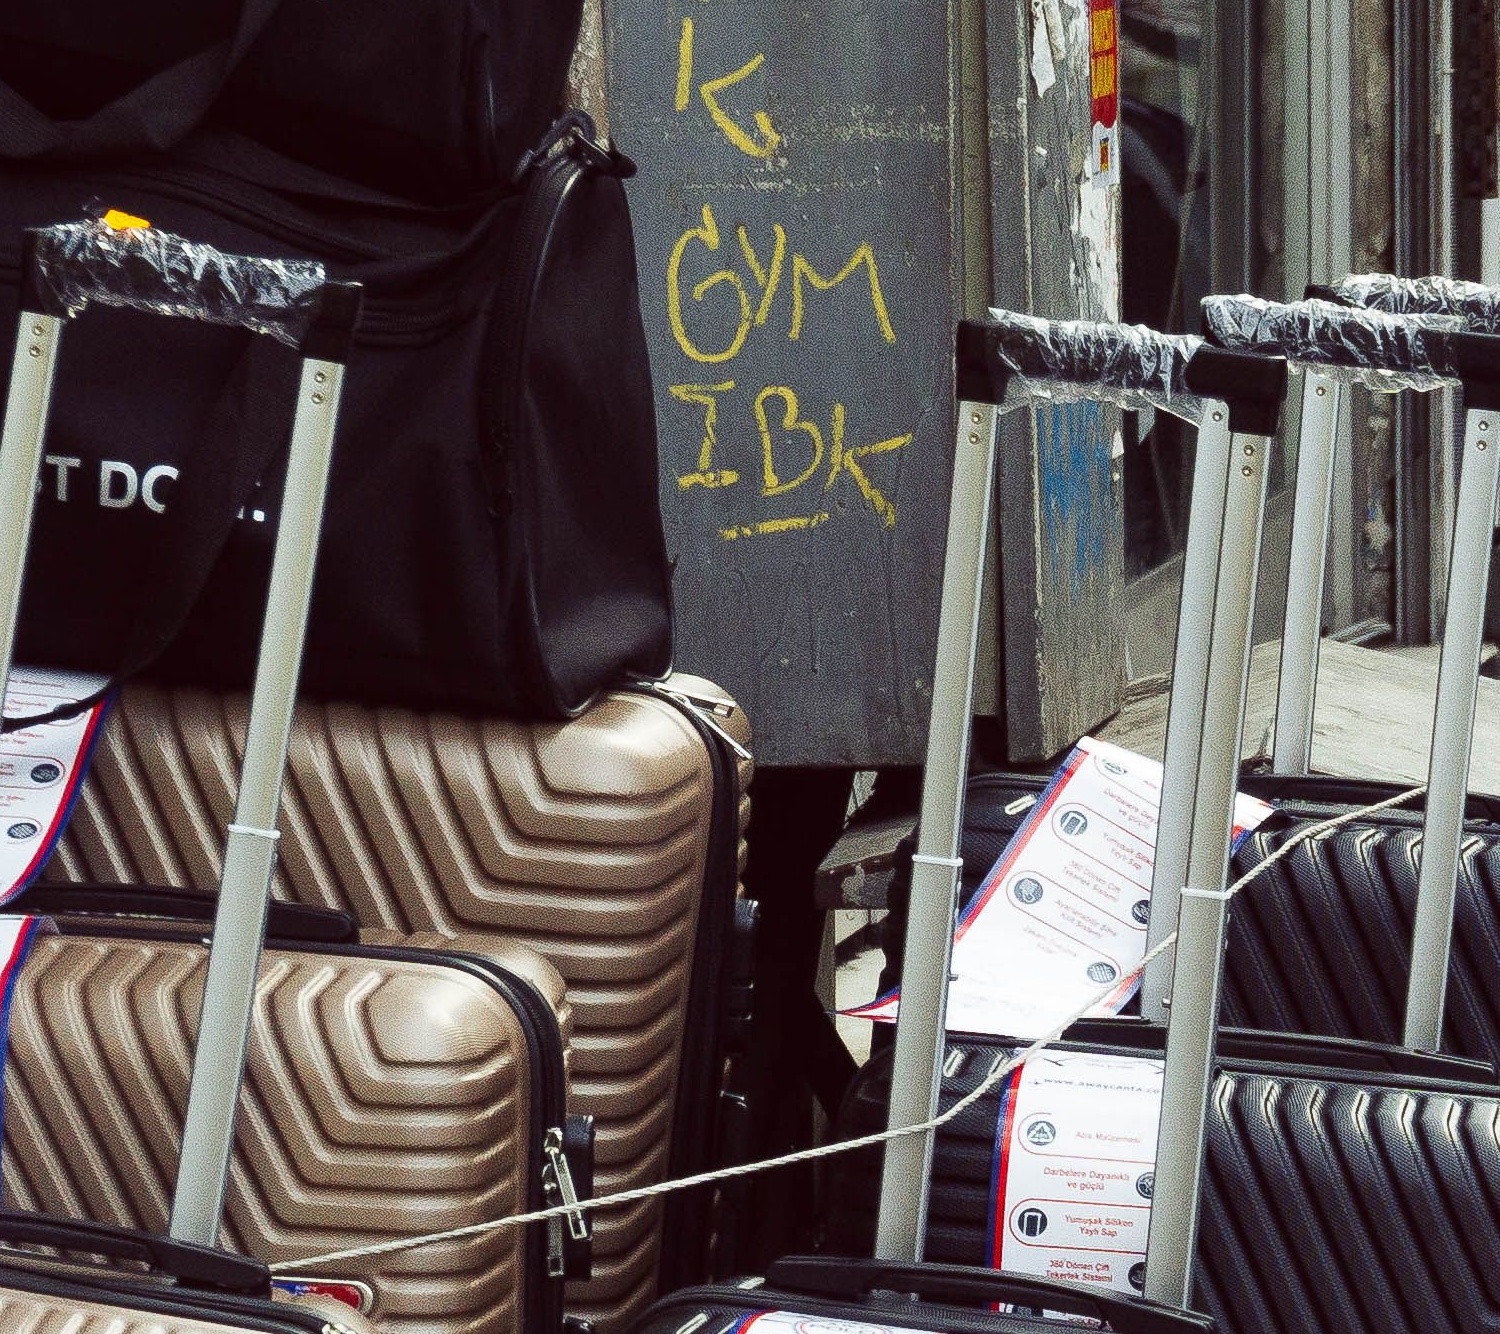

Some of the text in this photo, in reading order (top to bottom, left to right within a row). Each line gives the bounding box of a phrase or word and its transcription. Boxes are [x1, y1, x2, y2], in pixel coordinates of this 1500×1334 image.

[667, 203, 896, 364] GYM
[670, 379, 913, 526] IBK
[1043, 1077, 1161, 1094] www.awaycanta.co
[1043, 1166, 1087, 1178] Darbelere
